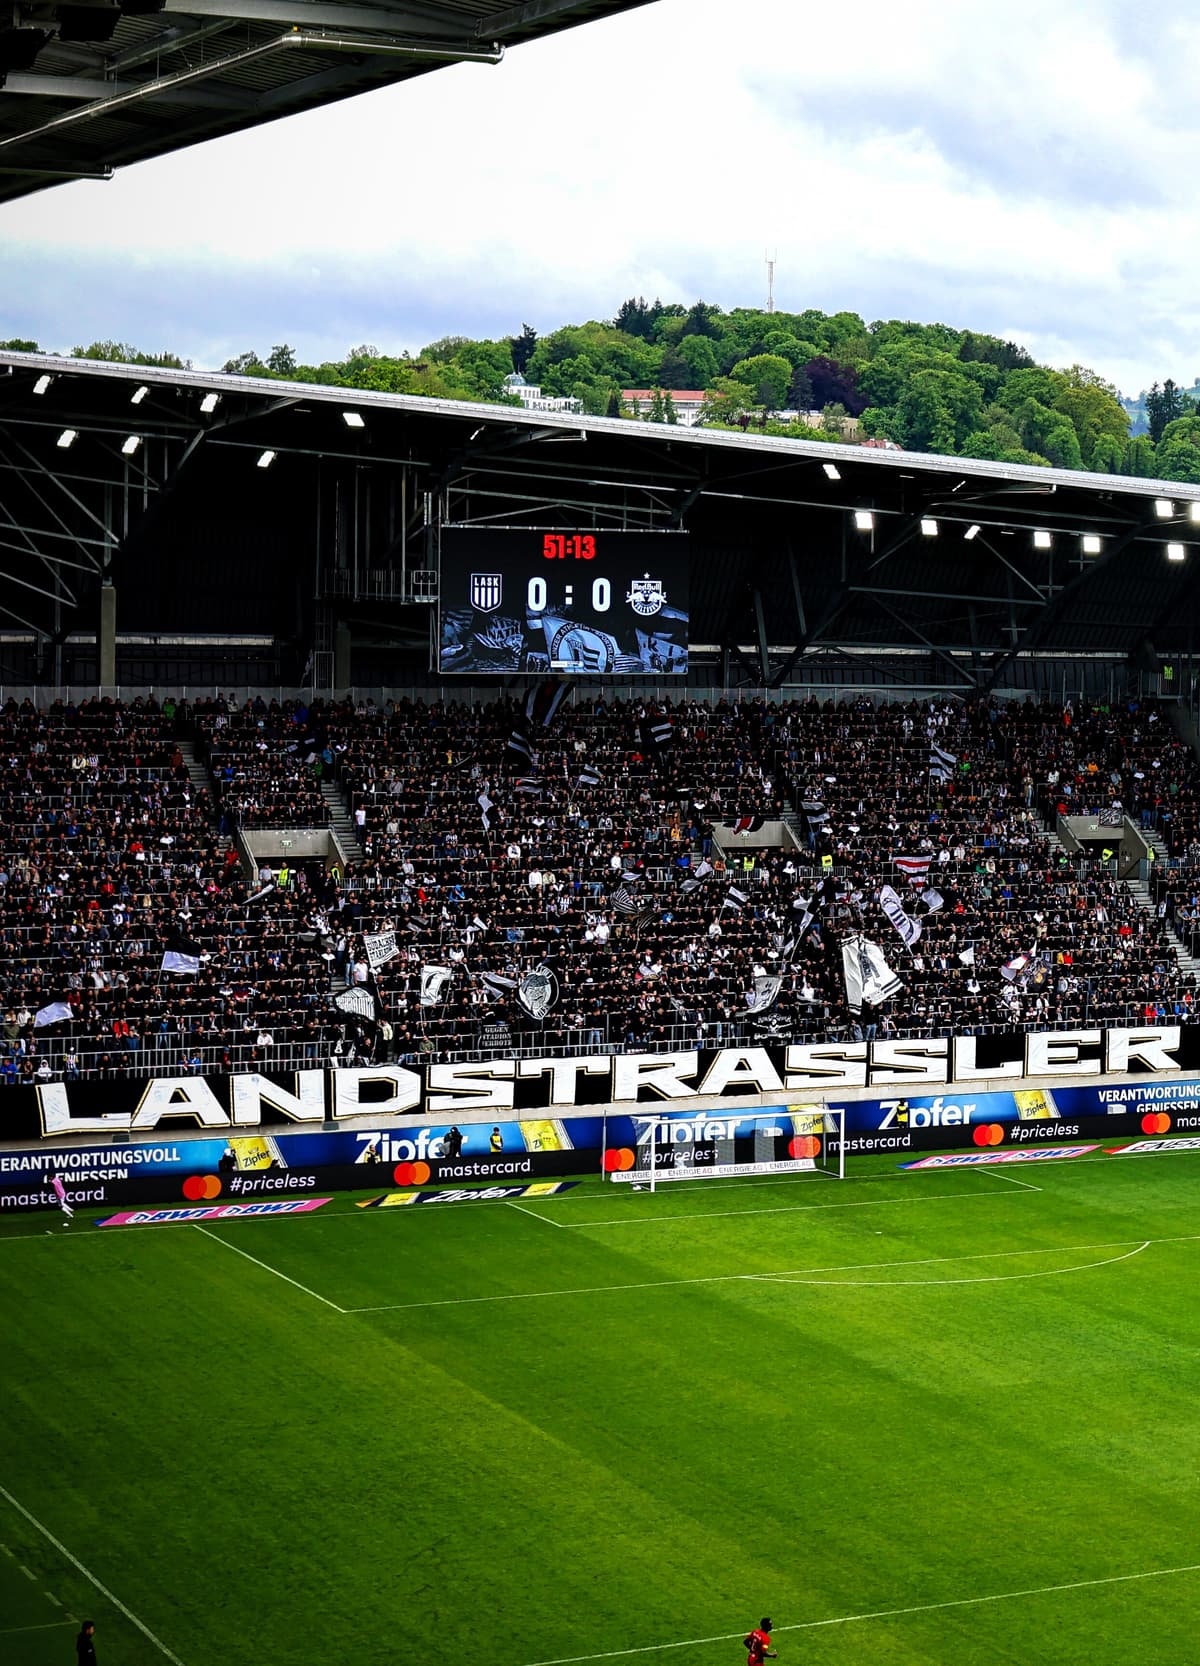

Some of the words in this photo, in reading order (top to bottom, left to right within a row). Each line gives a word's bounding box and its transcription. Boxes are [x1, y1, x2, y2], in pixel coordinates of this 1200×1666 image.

[543, 534, 596, 560] 51:13
[474, 577, 499, 587] LASK
[527, 577, 547, 612] 0
[592, 577, 611, 612] 0
[35, 1025, 1182, 1137] LANDSTRASSLER
[878, 1098, 977, 1131] Zpfer
[1026, 1102, 1047, 1117] Zipfer
[1010, 1123, 1080, 1142] #priceless
[828, 1133, 911, 1152] mastercard
[1, 1147, 181, 1172] ERANTWORTUNGSVOLL
[243, 1150, 270, 1168] Zipfer
[439, 1159, 531, 1178] mastercard
[230, 1173, 316, 1193] #priceless
[1, 1186, 105, 1207] mastecard
[423, 1186, 522, 1204] Zipfer
[150, 1207, 214, 1221] BWT
[241, 1201, 307, 1215] BWT
